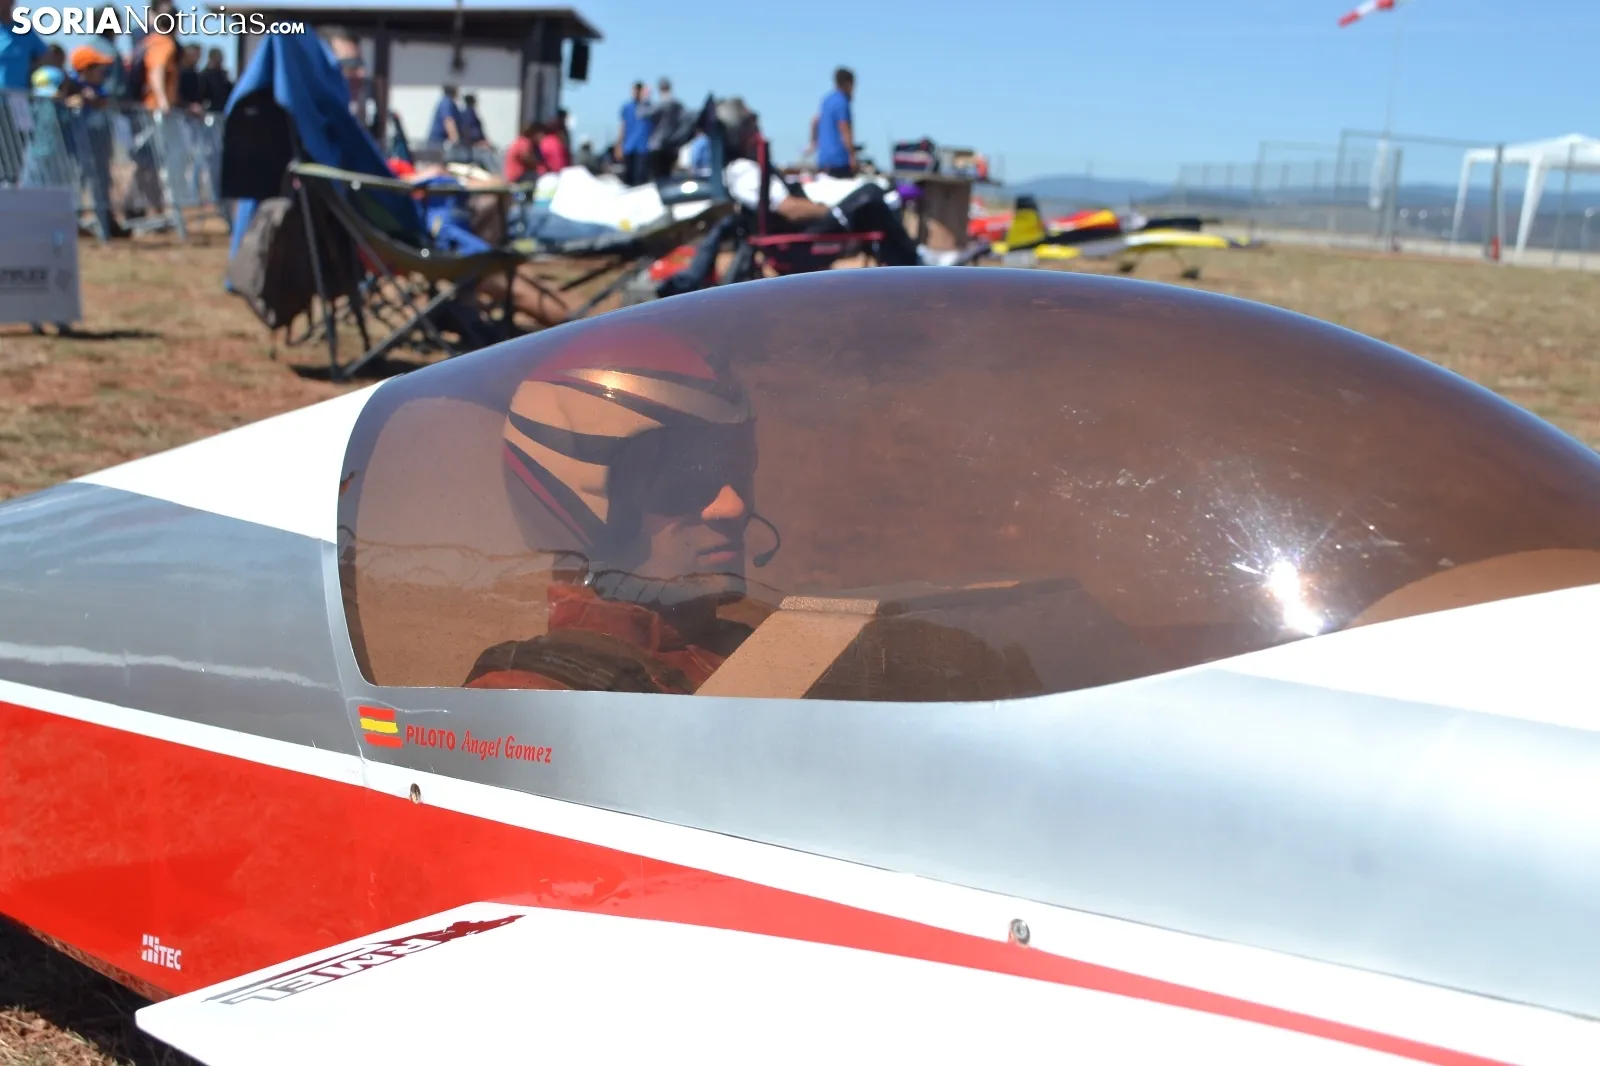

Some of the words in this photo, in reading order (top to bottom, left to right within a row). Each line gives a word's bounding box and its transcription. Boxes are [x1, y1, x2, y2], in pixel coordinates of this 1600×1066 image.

[405, 724, 456, 751] PILOTO
[460, 730, 501, 760] Angel
[504, 735, 552, 763] Gomez
